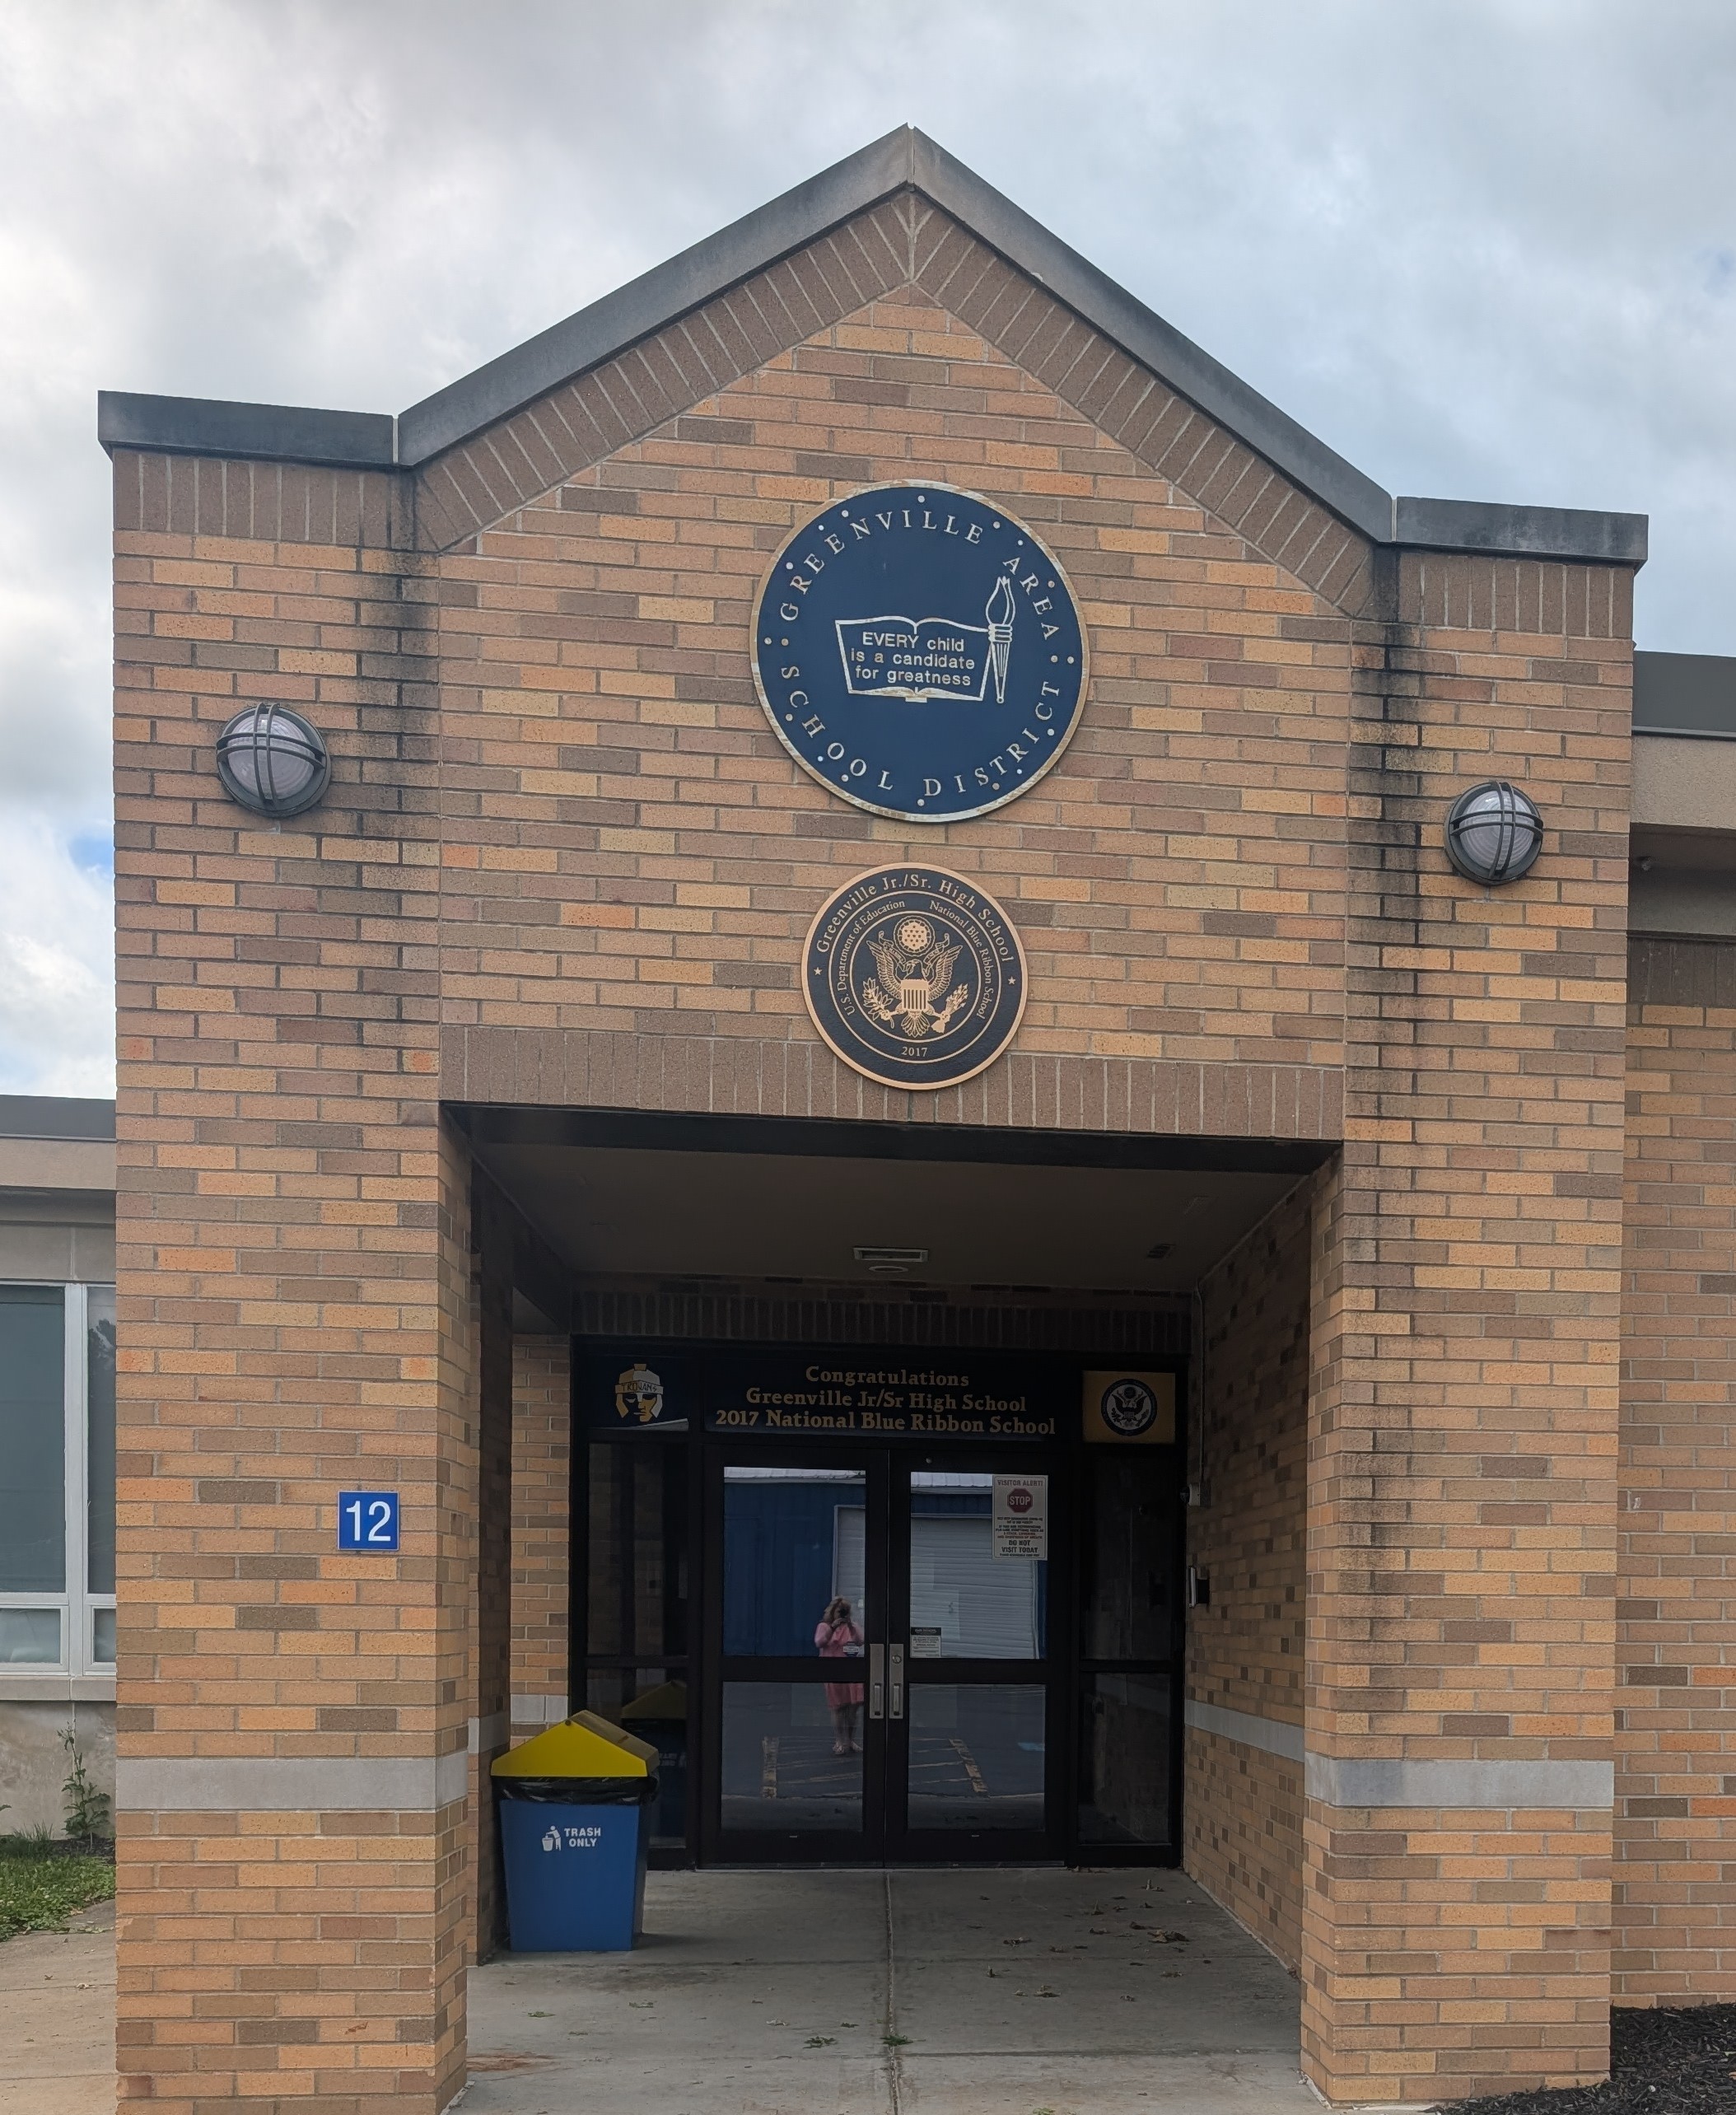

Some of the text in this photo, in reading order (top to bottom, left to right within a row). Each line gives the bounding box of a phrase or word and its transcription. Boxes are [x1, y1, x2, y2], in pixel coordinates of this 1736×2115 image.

[780, 510, 1060, 640] GREENVILLE AREA
[862, 632, 964, 651] EVERY child
[851, 648, 975, 670] is a candidate
[856, 665, 971, 686] for greatness
[781, 665, 1060, 796] SCHOOL DISTRICT
[816, 885, 877, 954] Greenville
[882, 874, 931, 890] Jr./Sr.
[940, 880, 976, 909] High
[978, 908, 1015, 963] School
[858, 899, 906, 928] Education
[930, 900, 969, 929] National
[853, 922, 863, 935] of
[965, 925, 983, 948] Blue
[837, 933, 856, 991] Department
[979, 948, 993, 985] Ribbon
[840, 992, 856, 1016] U.S.
[976, 987, 994, 1020] School
[901, 1046, 928, 1057] 2017
[622, 1382, 657, 1392] TROJANS
[805, 1366, 969, 1387] Congratulations
[746, 1387, 1026, 1412] Greenville Jr/Sr High School
[715, 1409, 1055, 1435] 2017 National Blue Ribbon School
[1010, 1496, 1031, 1506] STOP
[346, 1501, 391, 1541] 12
[564, 1827, 601, 1837] TRASH
[568, 1837, 597, 1847] ONLY
